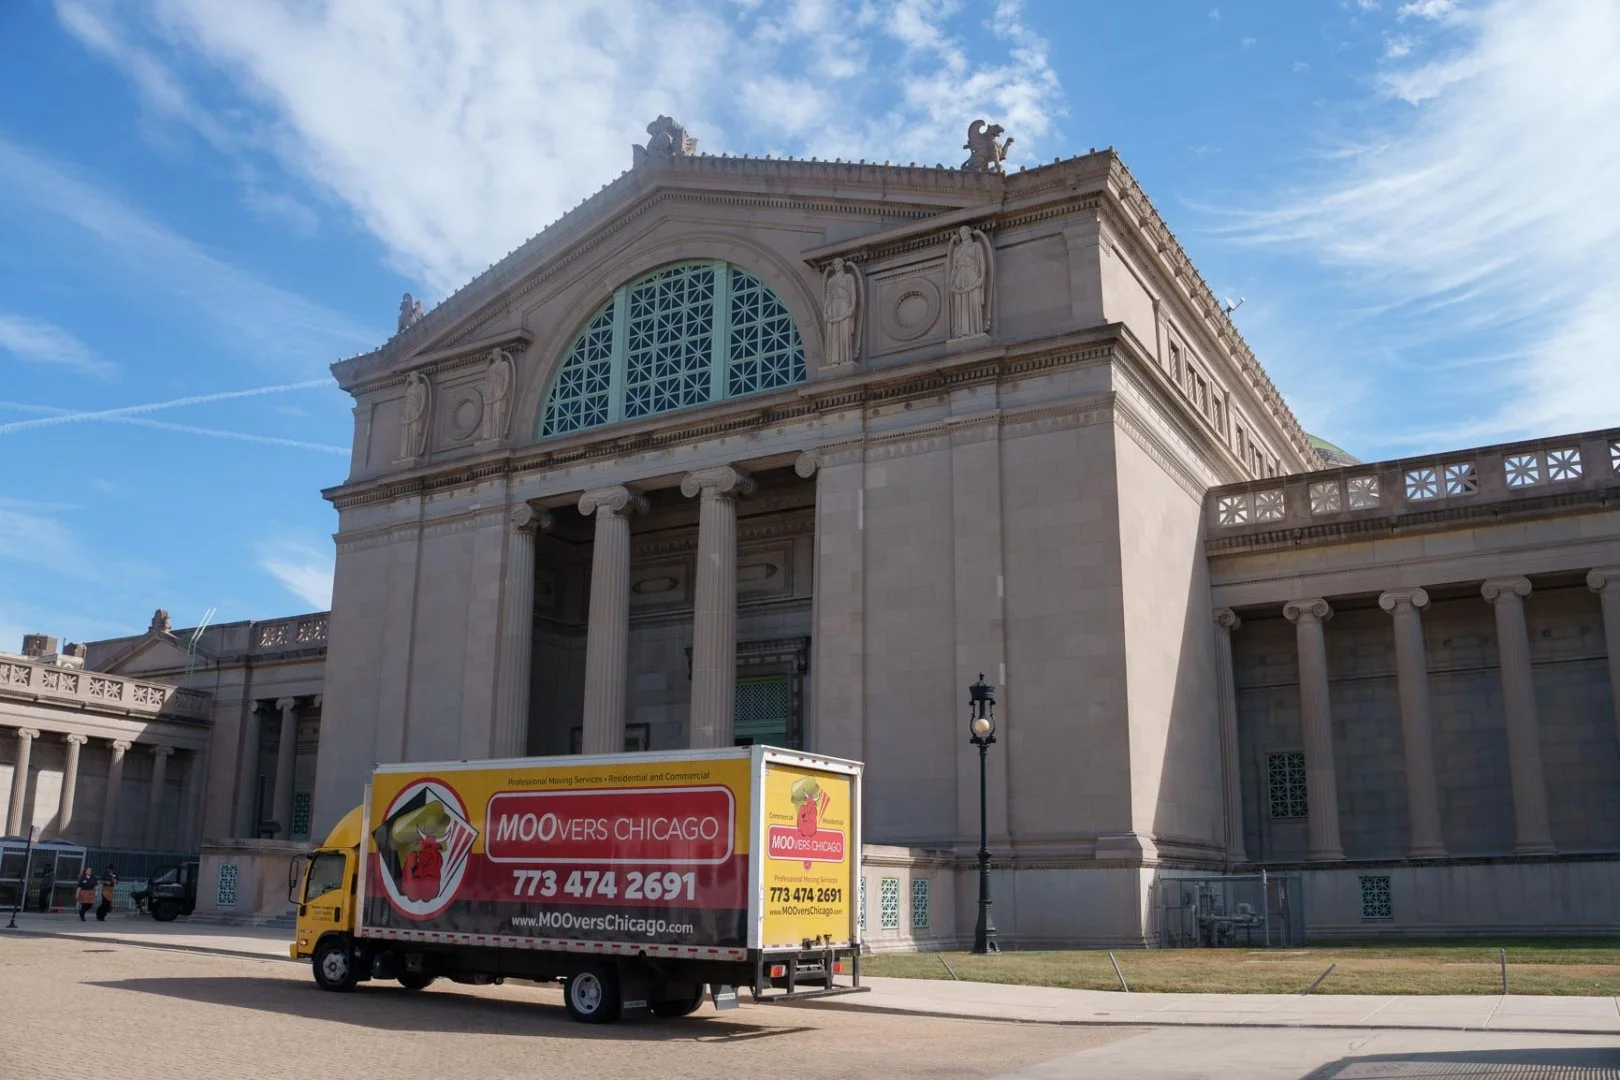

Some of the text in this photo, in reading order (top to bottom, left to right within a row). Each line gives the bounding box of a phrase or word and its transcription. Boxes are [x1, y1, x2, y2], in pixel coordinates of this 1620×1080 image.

[508, 771, 710, 786] Professional Moving Services Residential and Commercial
[614, 816, 719, 841] CHICAGO
[812, 840, 841, 853] CHICAGO
[513, 869, 695, 901] 773 474 2691
[804, 875, 819, 884] Moving
[770, 886, 842, 903] 773 474 2691
[769, 906, 842, 917] www.MOOversChicago.com
[512, 912, 693, 936] www.MOOversChicago.com
